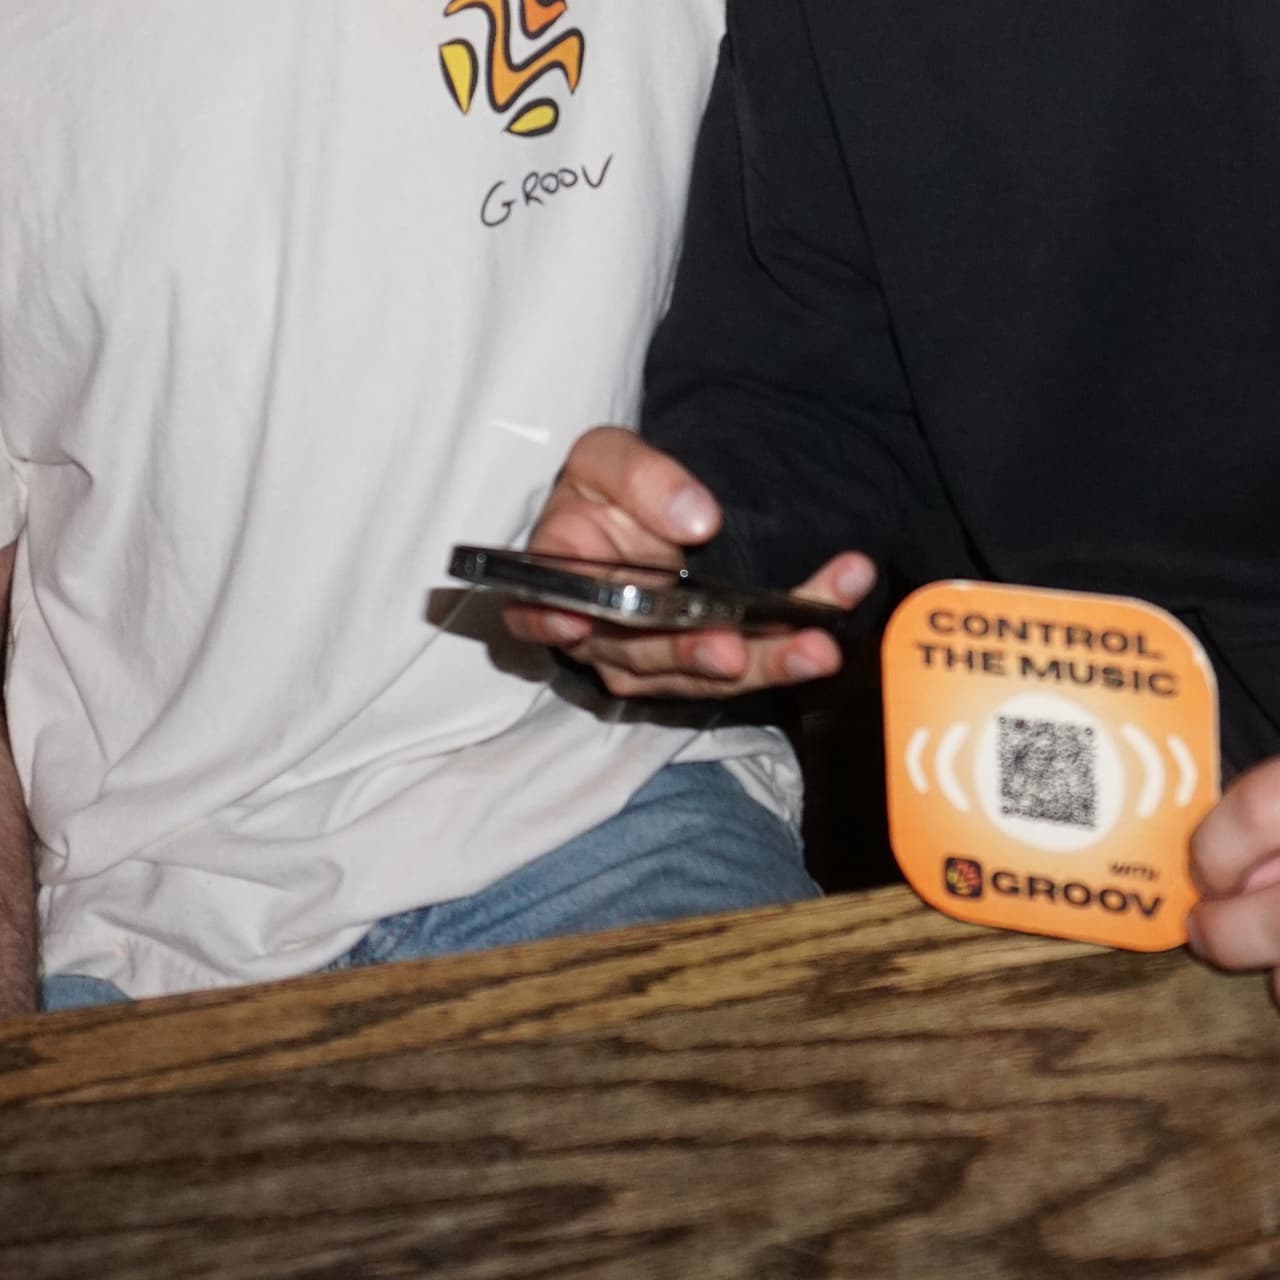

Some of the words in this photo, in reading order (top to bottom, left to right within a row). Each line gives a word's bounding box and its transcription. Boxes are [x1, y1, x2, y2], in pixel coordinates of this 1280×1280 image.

[480, 152, 614, 228] GROOV
[927, 608, 1163, 660] CONTROL
[914, 642, 1008, 676] THE
[1019, 655, 1181, 698] MUSIC
[991, 870, 1162, 918] GROOV
